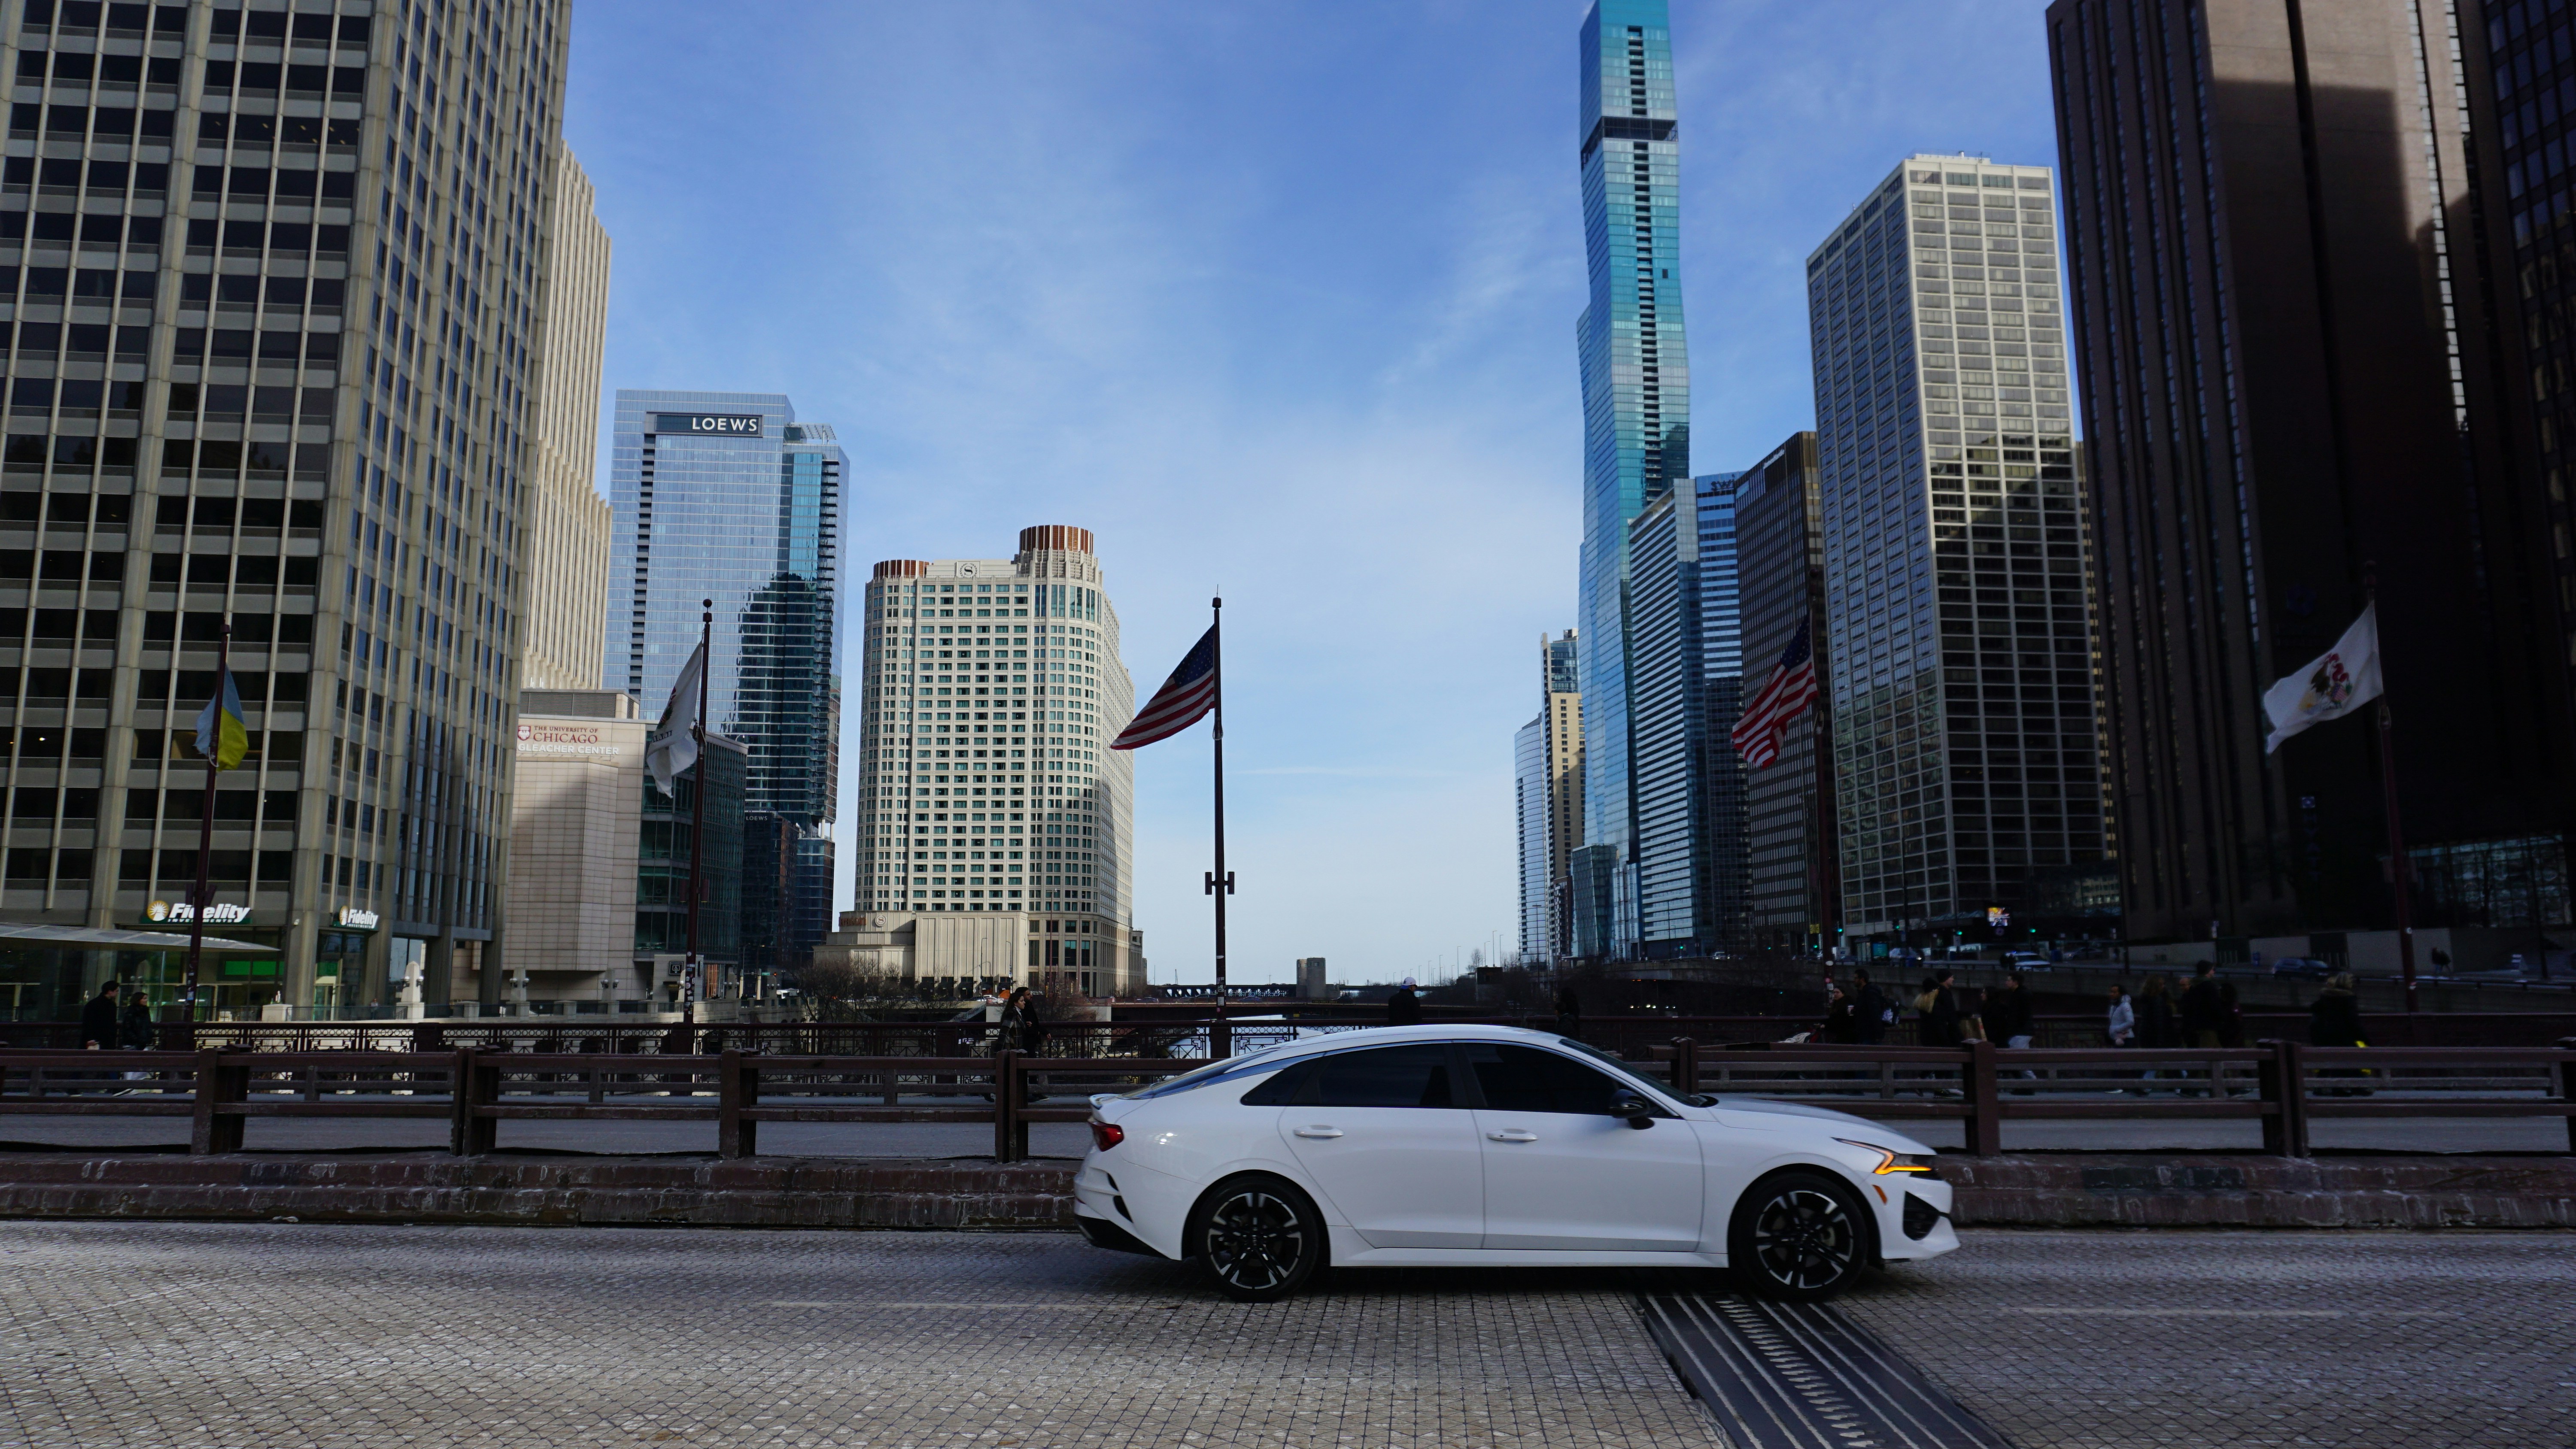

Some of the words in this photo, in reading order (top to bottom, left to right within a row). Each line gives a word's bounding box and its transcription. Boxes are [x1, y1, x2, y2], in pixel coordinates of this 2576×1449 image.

[692, 417, 757, 431] LOEWS
[533, 732, 598, 744] CHICAGO
[518, 743, 574, 753] GLEACHER
[577, 746, 619, 755] CENTER
[348, 909, 379, 929] Fidelity
